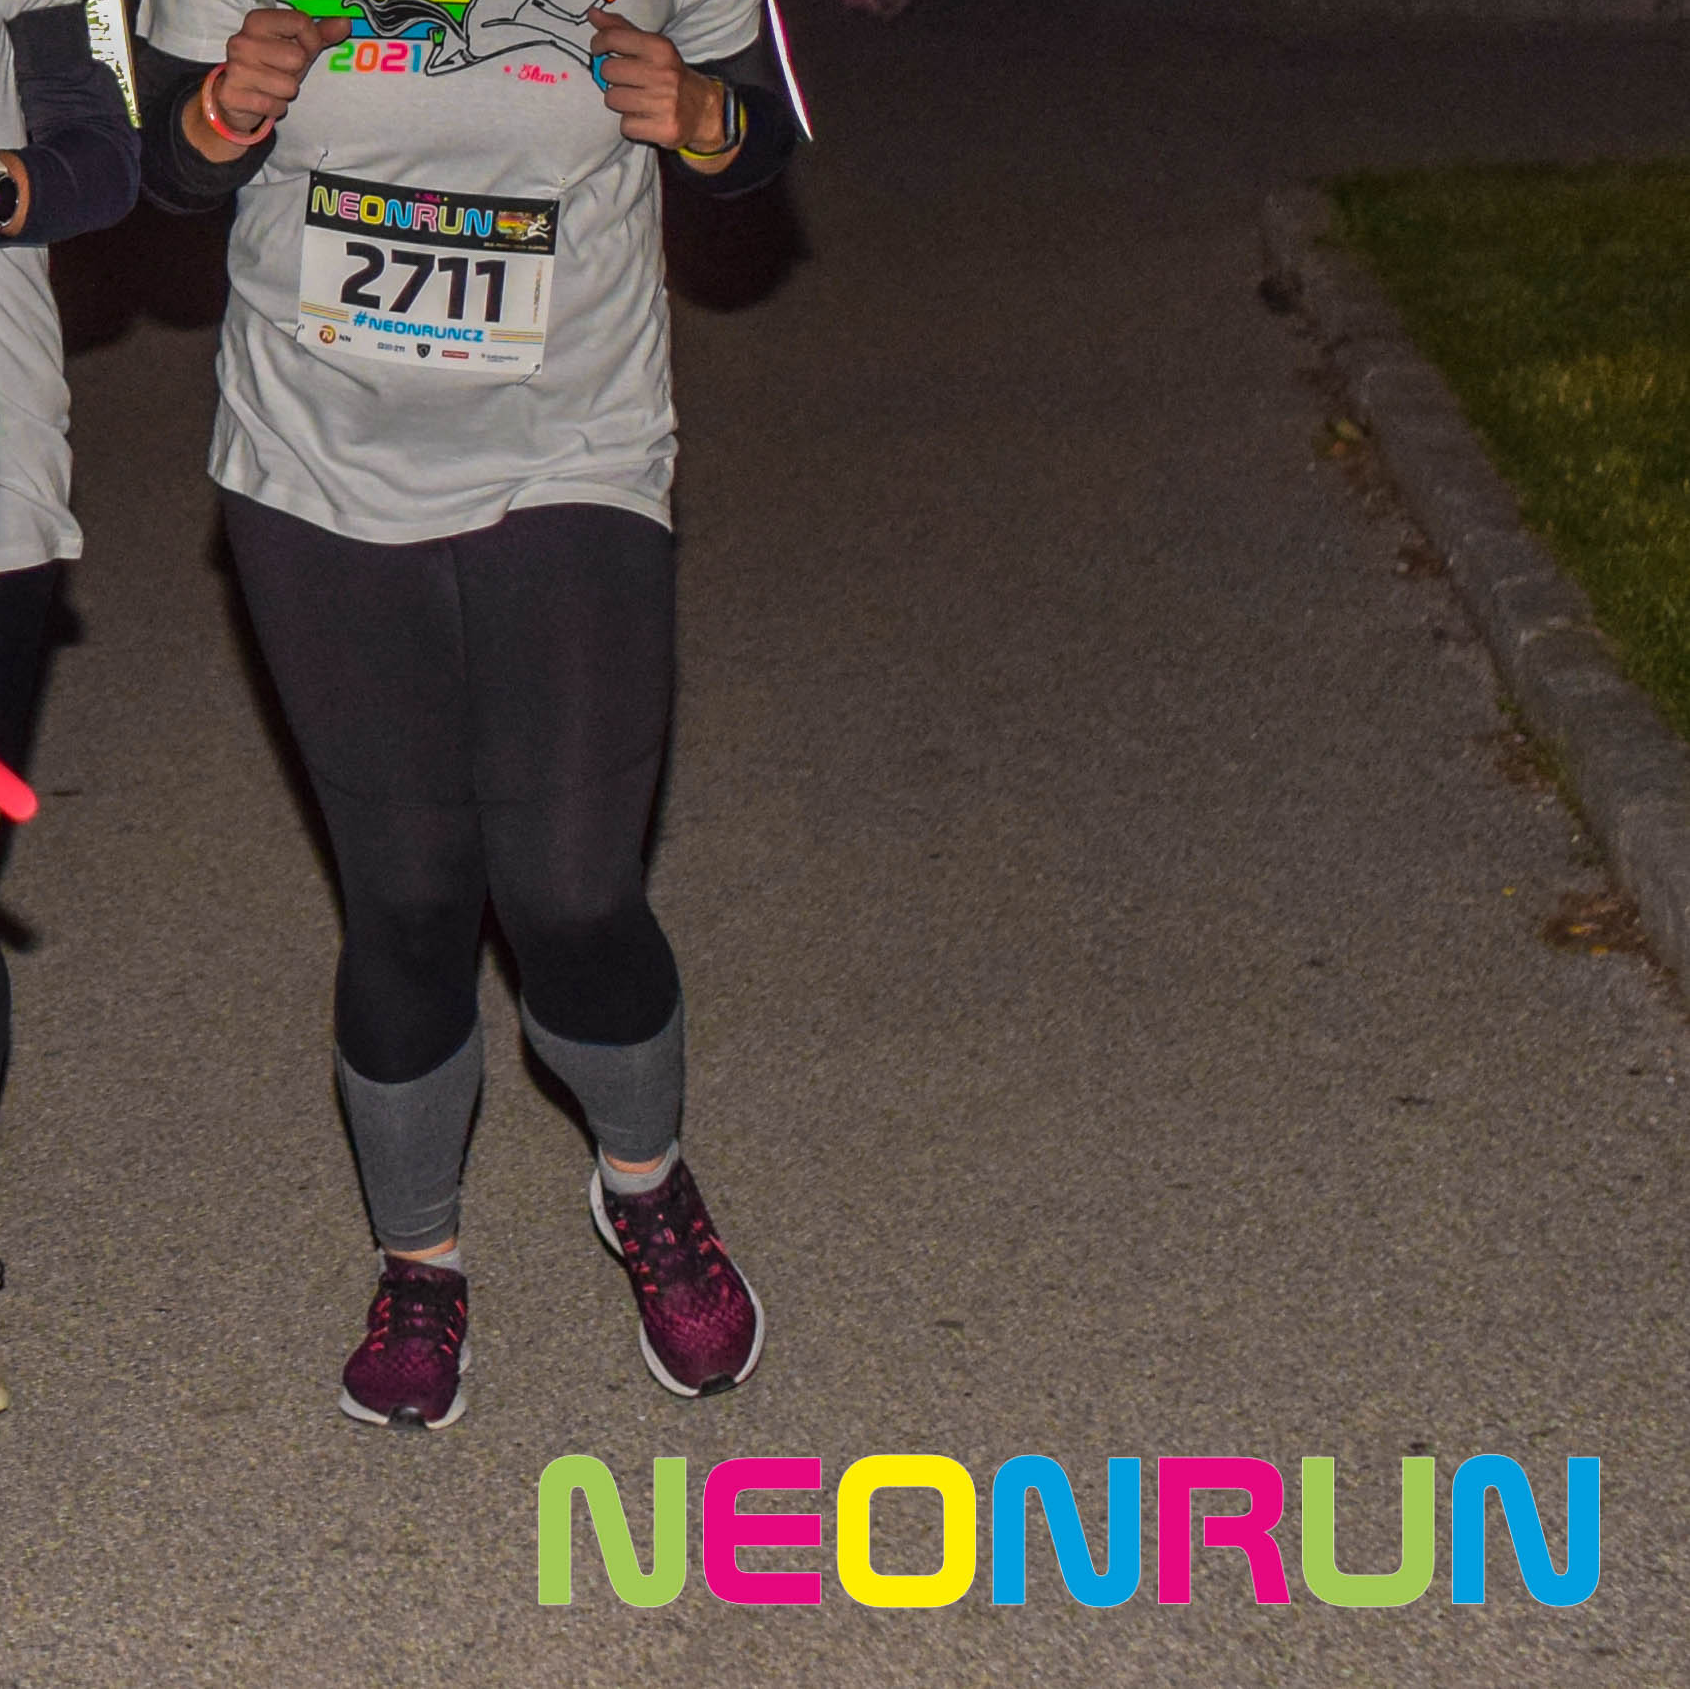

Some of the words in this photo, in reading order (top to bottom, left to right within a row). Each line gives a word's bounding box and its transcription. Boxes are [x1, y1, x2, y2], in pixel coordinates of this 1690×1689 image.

[328, 41, 423, 73] 2021
[311, 185, 493, 238] NEONRUN
[340, 241, 507, 323] 2711
[352, 311, 485, 343] #NEONRUNCZ
